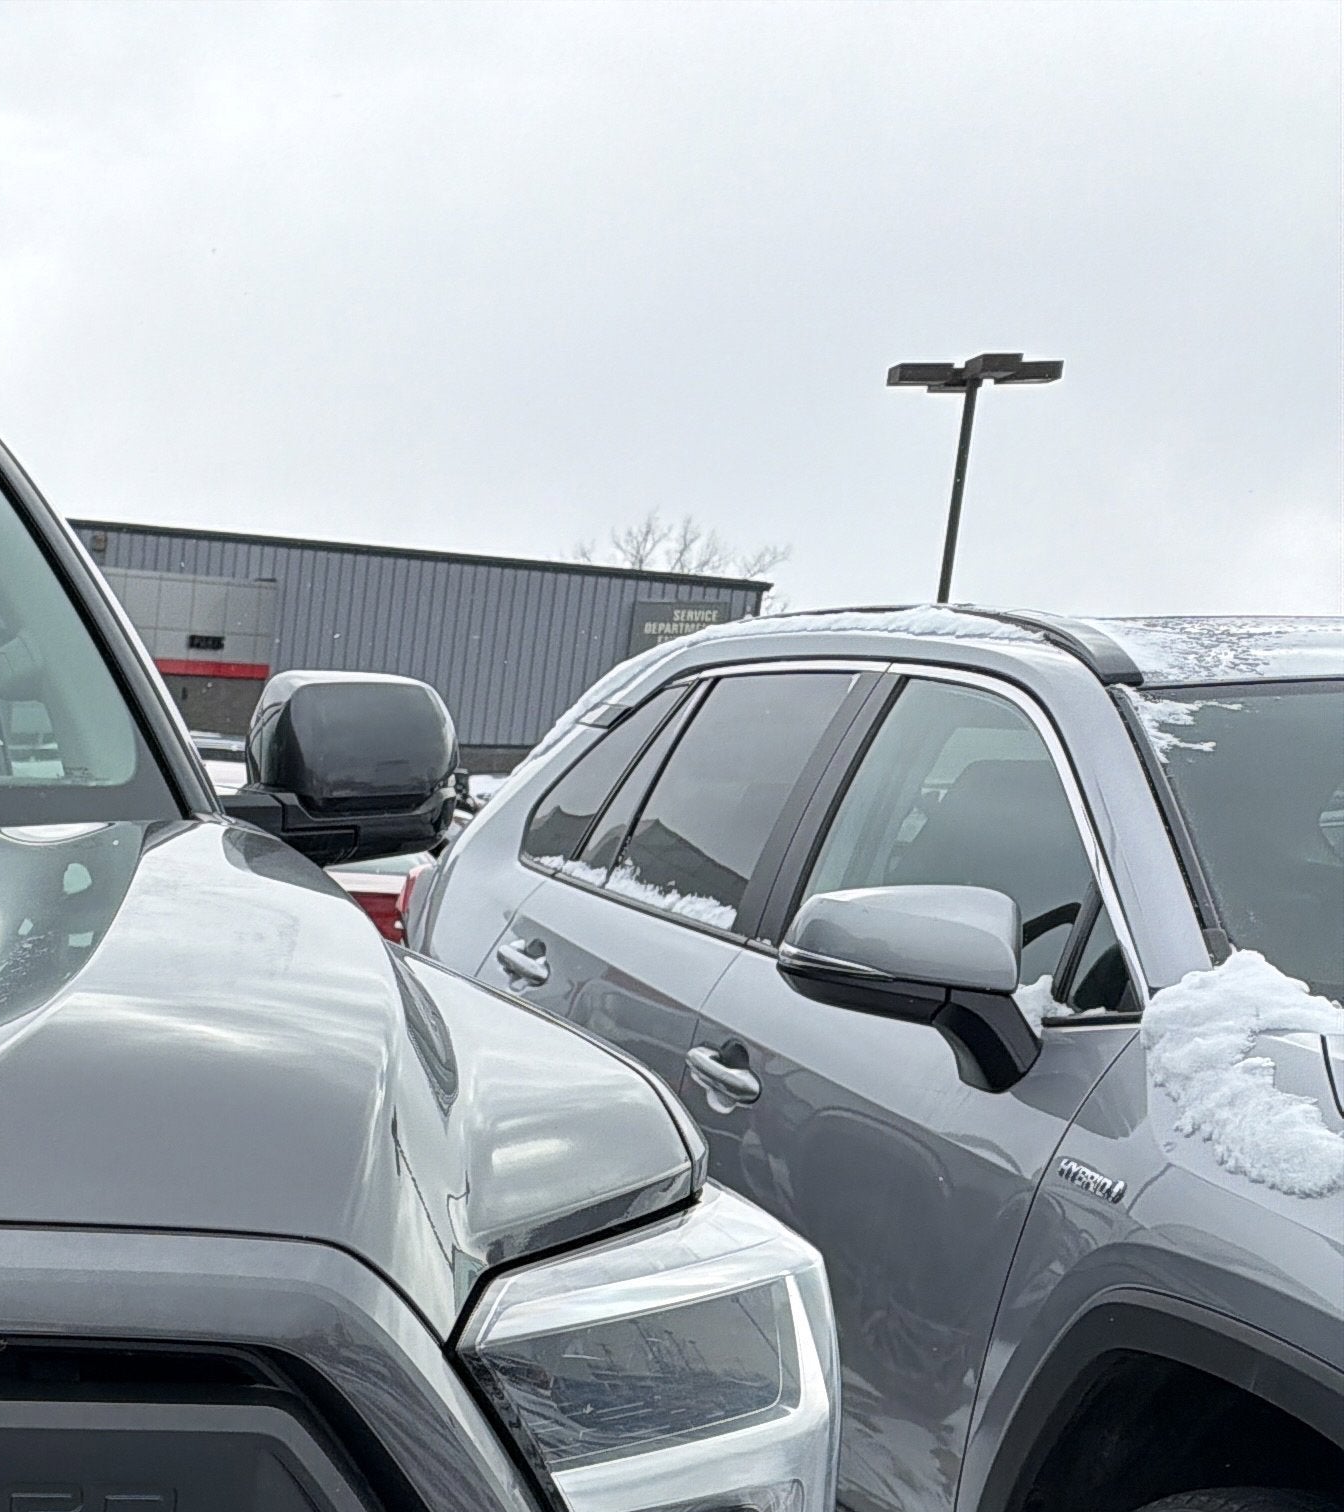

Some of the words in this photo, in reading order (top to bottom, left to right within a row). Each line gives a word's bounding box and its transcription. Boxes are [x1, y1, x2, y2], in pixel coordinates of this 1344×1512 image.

[673, 608, 718, 622] SERVICE
[644, 621, 707, 635] DEPARTME
[1059, 1158, 1114, 1200] HYBRID
